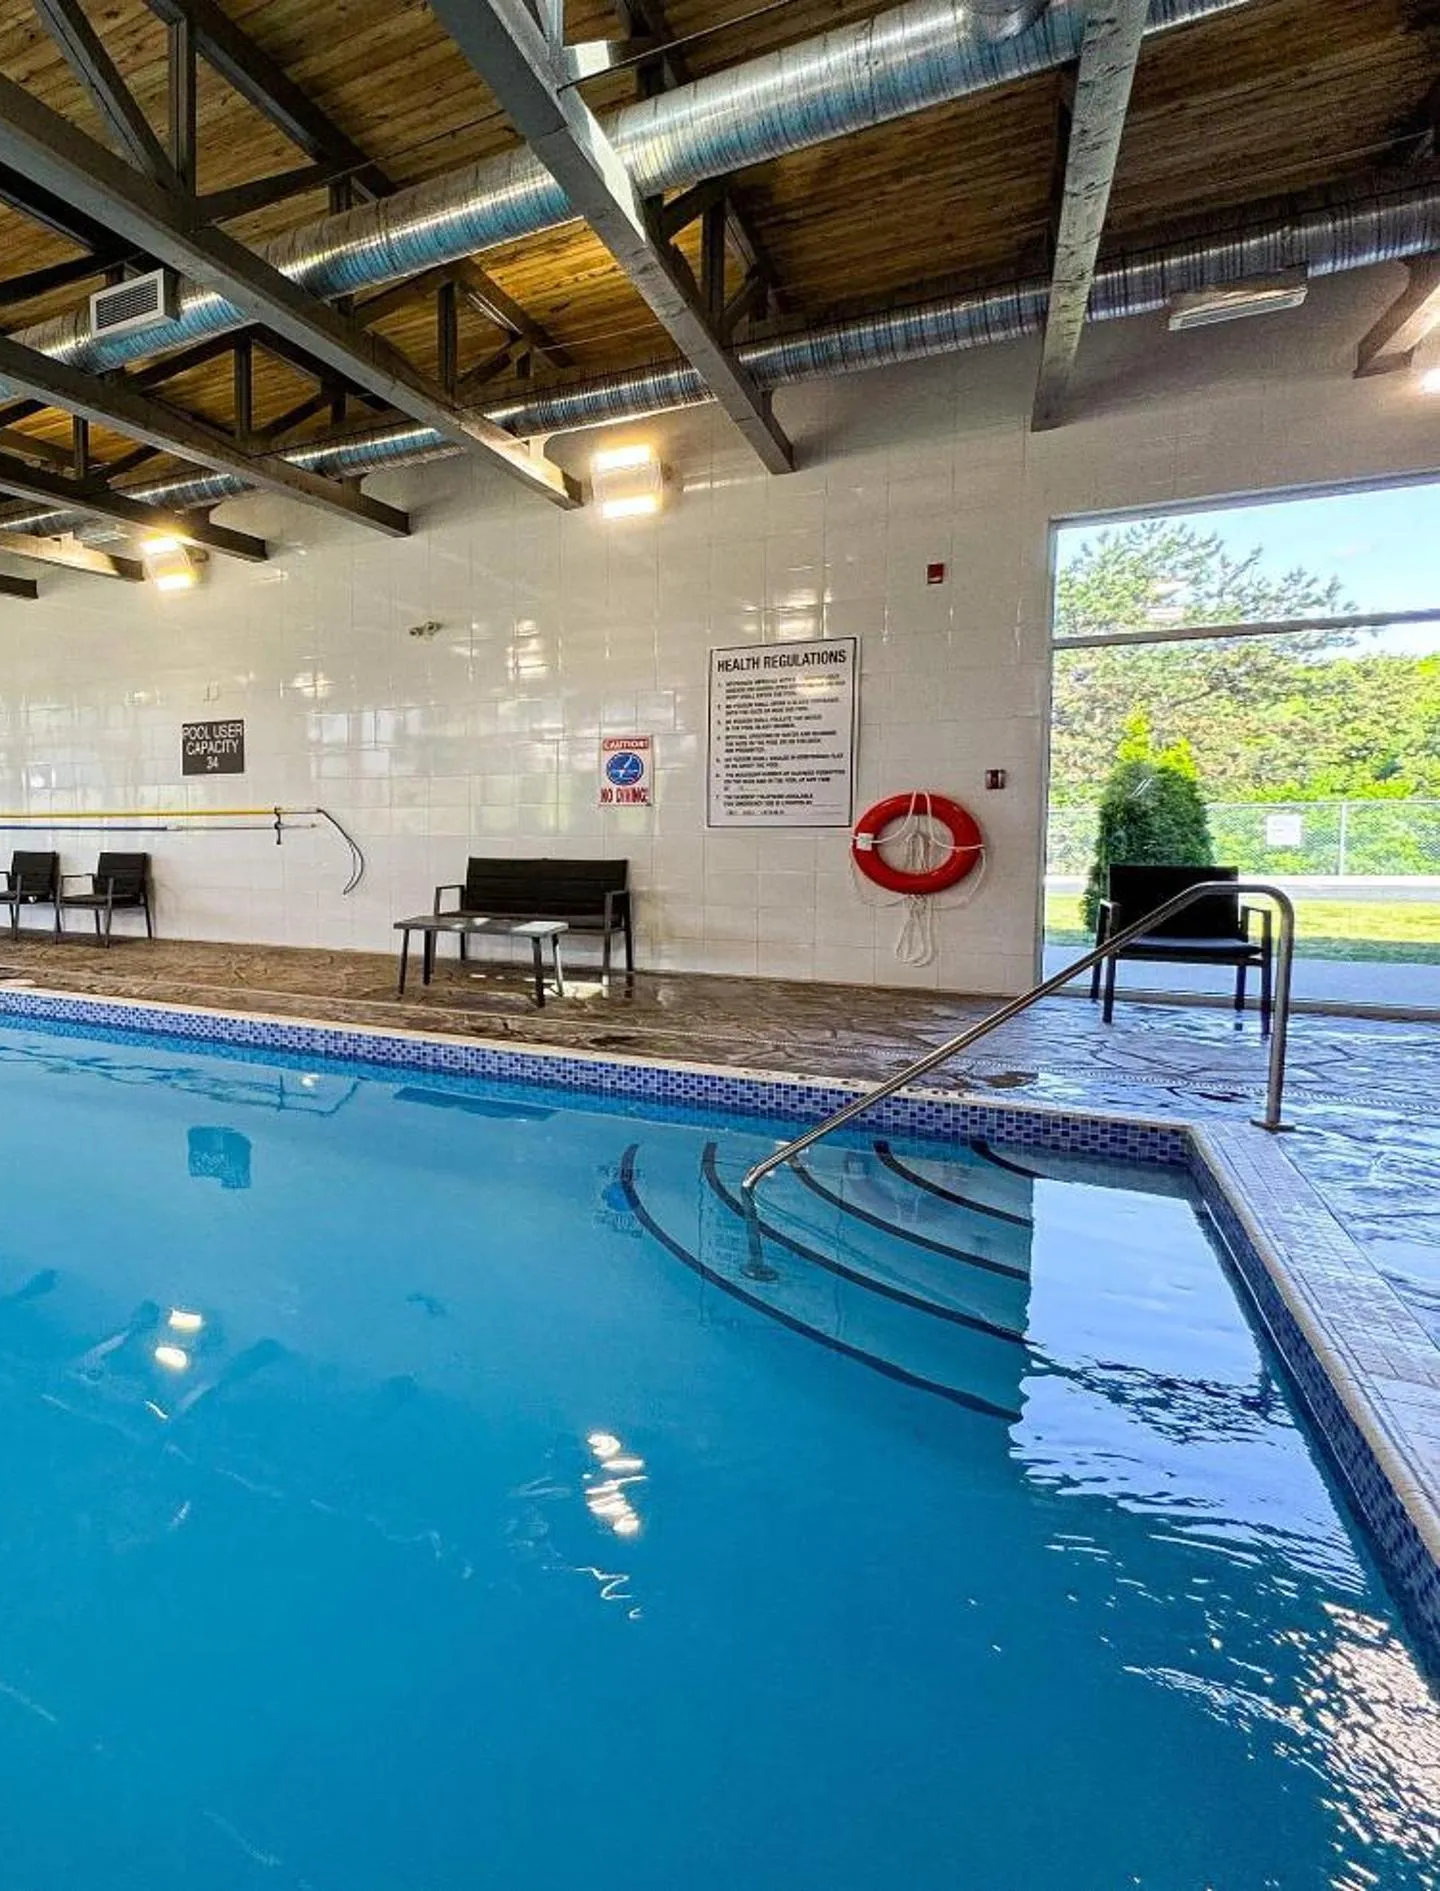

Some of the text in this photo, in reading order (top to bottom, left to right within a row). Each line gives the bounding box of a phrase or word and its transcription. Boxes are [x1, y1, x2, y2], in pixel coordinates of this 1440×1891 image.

[717, 650, 847, 672] HEALTH REGULATIONS
[183, 723, 242, 740] POOL USER
[186, 739, 239, 755] CAPACITY
[206, 755, 219, 769] 34
[600, 788, 613, 803] NO
